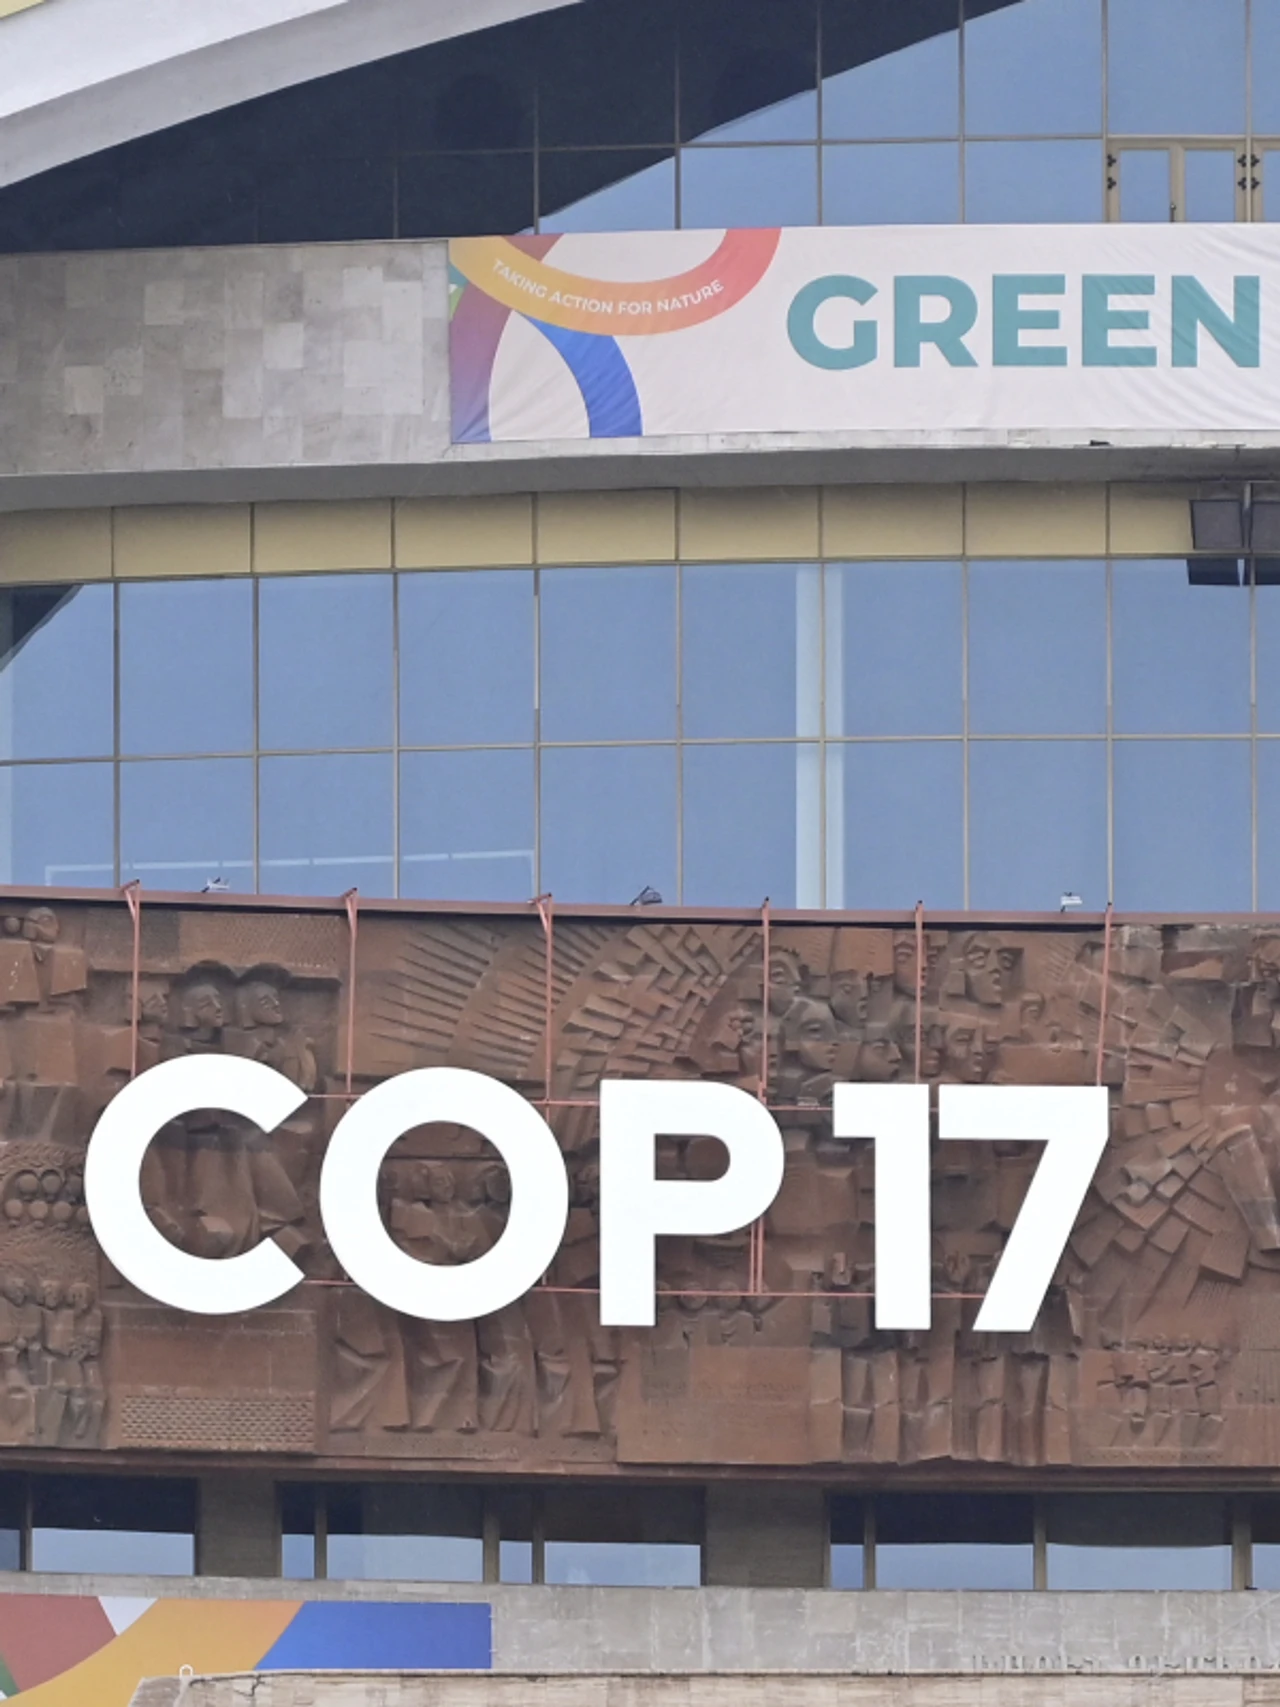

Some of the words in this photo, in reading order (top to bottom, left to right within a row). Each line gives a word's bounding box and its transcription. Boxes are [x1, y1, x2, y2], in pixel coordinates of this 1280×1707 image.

[493, 259, 547, 298] TAKING
[548, 291, 613, 314] ACTION
[618, 301, 651, 315] FOR
[657, 279, 724, 313] NATURE
[788, 275, 1260, 370] GREEN
